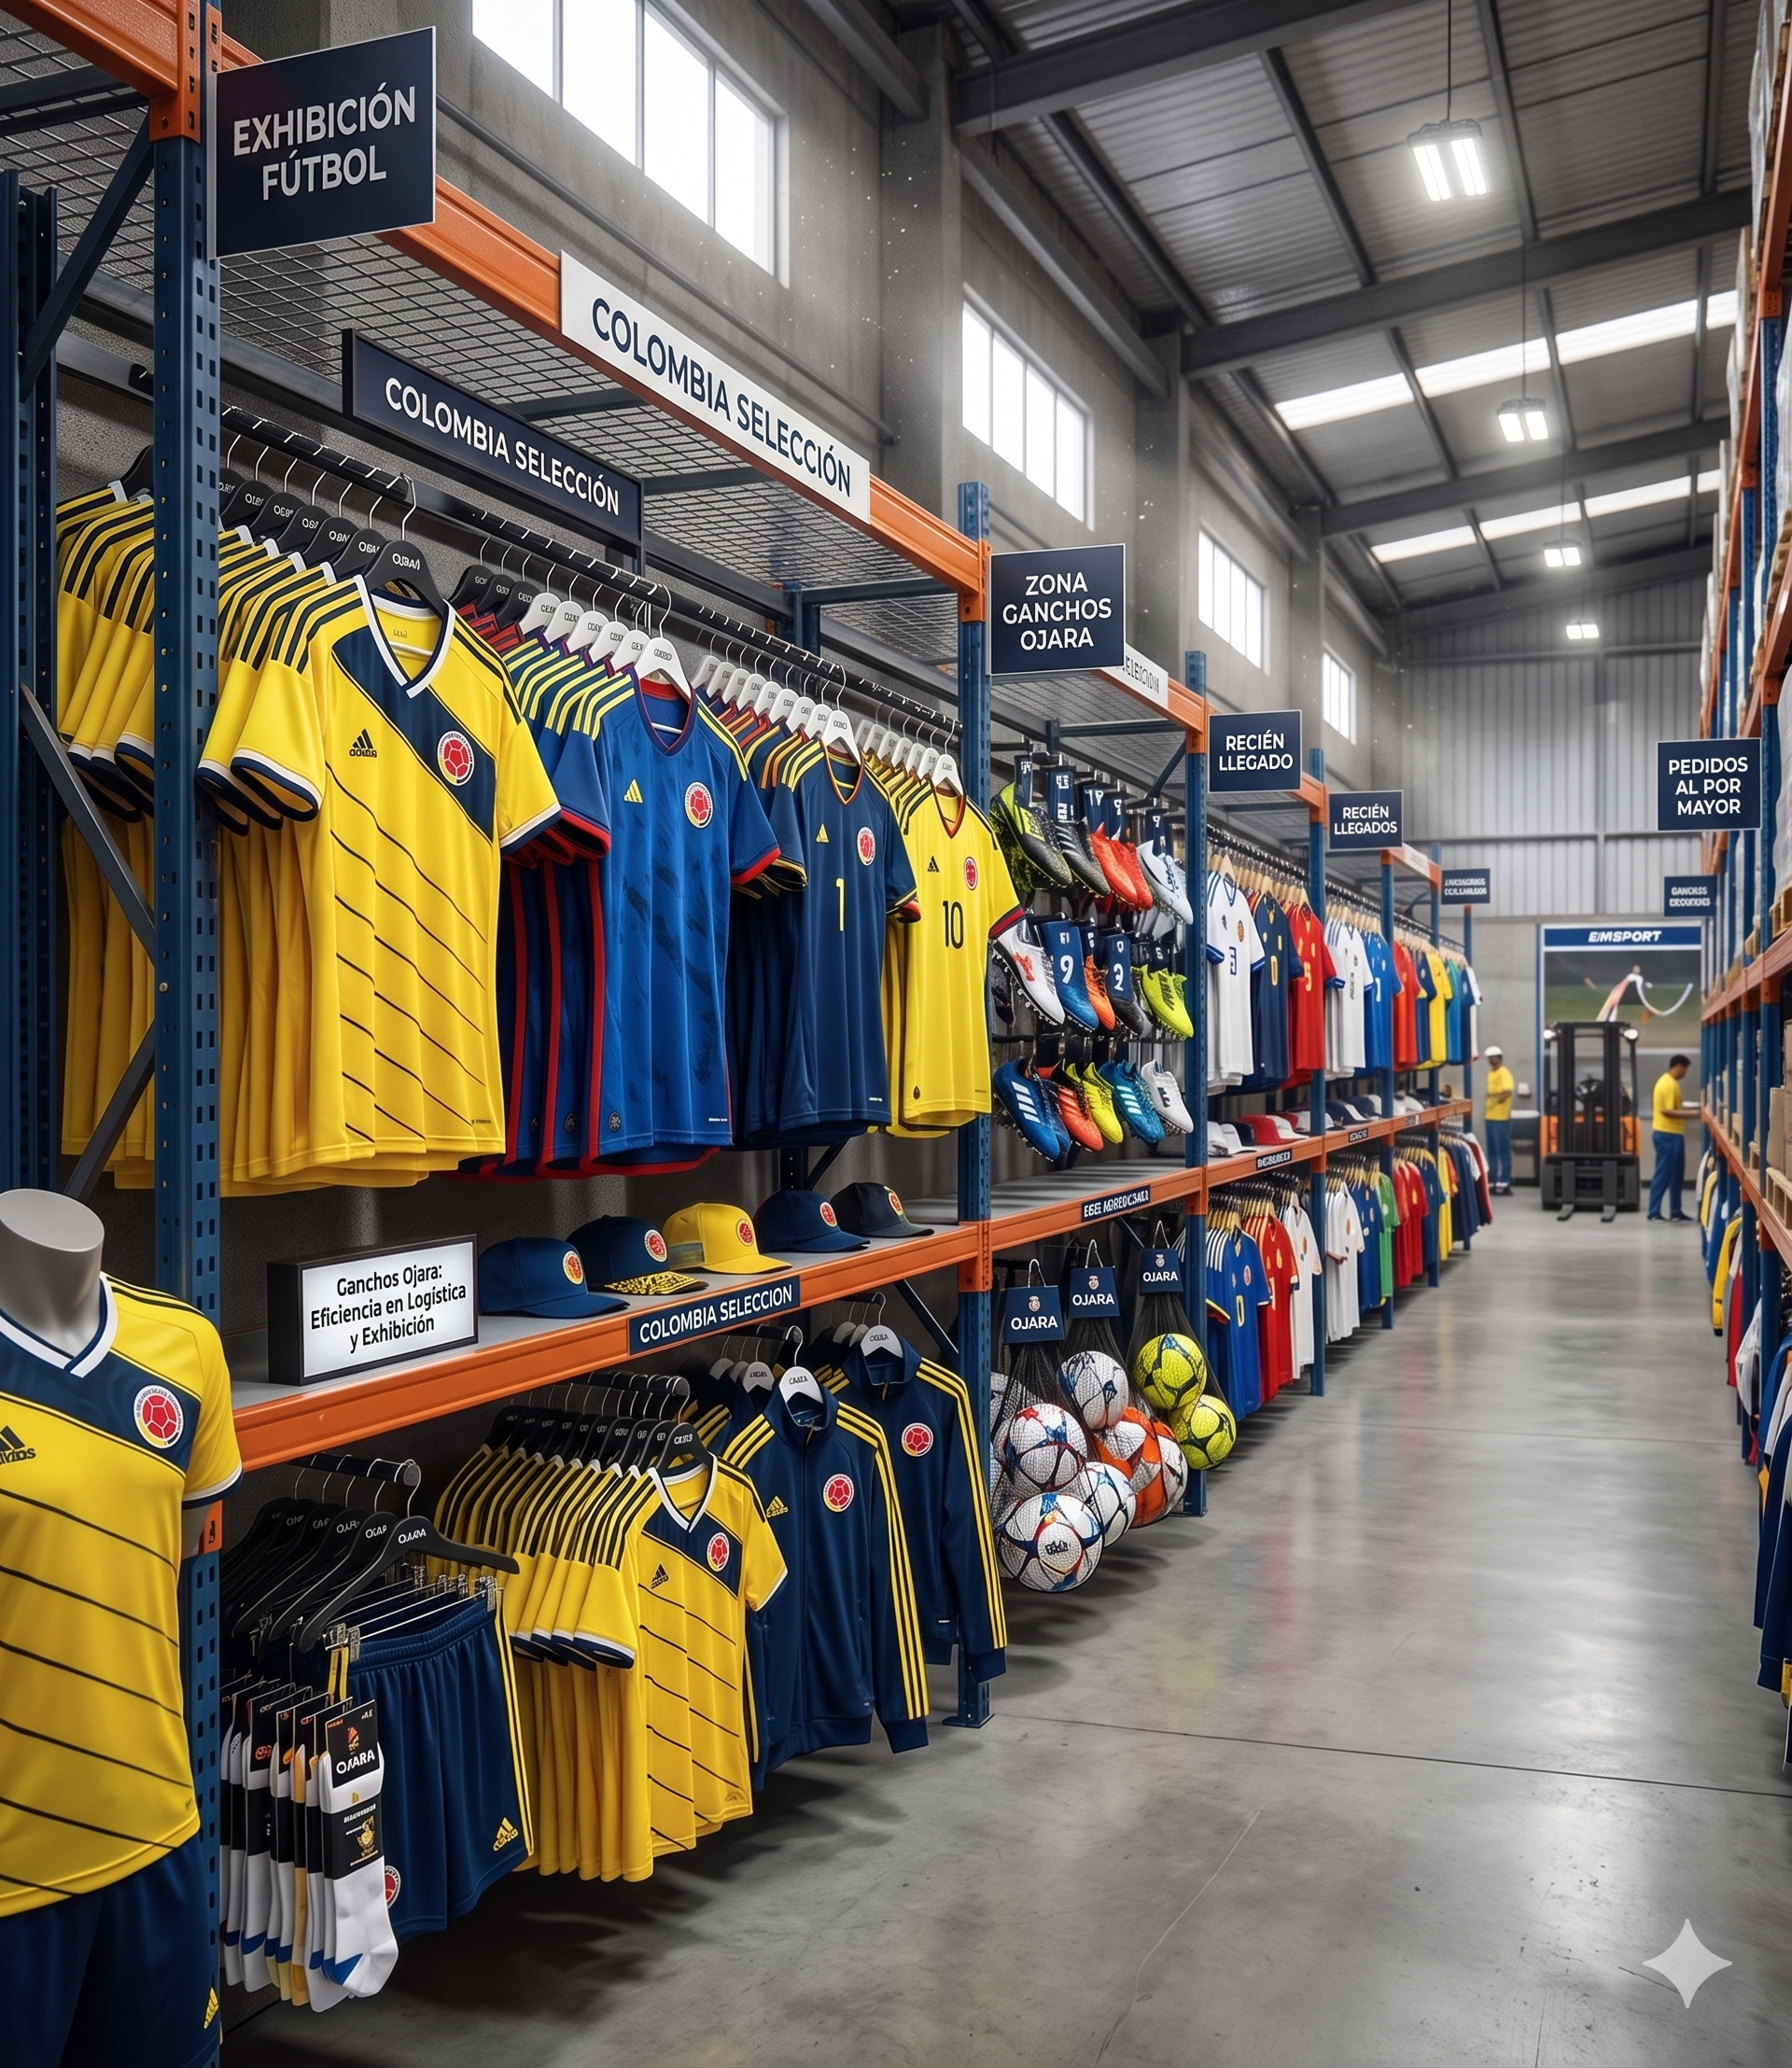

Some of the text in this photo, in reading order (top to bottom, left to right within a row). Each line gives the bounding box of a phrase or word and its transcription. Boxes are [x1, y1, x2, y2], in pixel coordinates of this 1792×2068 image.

[233, 81, 415, 157] EXHIBICIÓN
[262, 149, 387, 201] FÚTBOL
[591, 297, 851, 498] COLOMBIA SELECCIÓN
[385, 377, 620, 516] COLOMBIA SELECCIÓN
[1025, 571, 1088, 596] ZONA
[1002, 597, 1113, 624] GANCHOS
[1020, 626, 1095, 651] OJARA
[1225, 729, 1284, 751] RECIÉN
[1219, 753, 1294, 772] LLEGADO
[1669, 756, 1748, 776] PEDIDOS
[1674, 777, 1742, 796] AL POR
[1342, 803, 1390, 818] RECIÉN
[1677, 798, 1742, 816] MAYOR
[1334, 821, 1398, 835] LLEGADOS
[835, 877, 845, 932] 1
[942, 901, 964, 950] 10
[337, 1265, 442, 1297] Ganchos Ojara:
[1141, 1269, 1179, 1283] OJARA
[311, 1283, 467, 1330] Eficiencia en Logística
[1071, 1292, 1115, 1306] OJARA
[639, 1285, 792, 1344] COLOMBIA SELECCION
[1011, 1315, 1058, 1331] OJARA
[350, 1314, 435, 1354] y Exhibición
